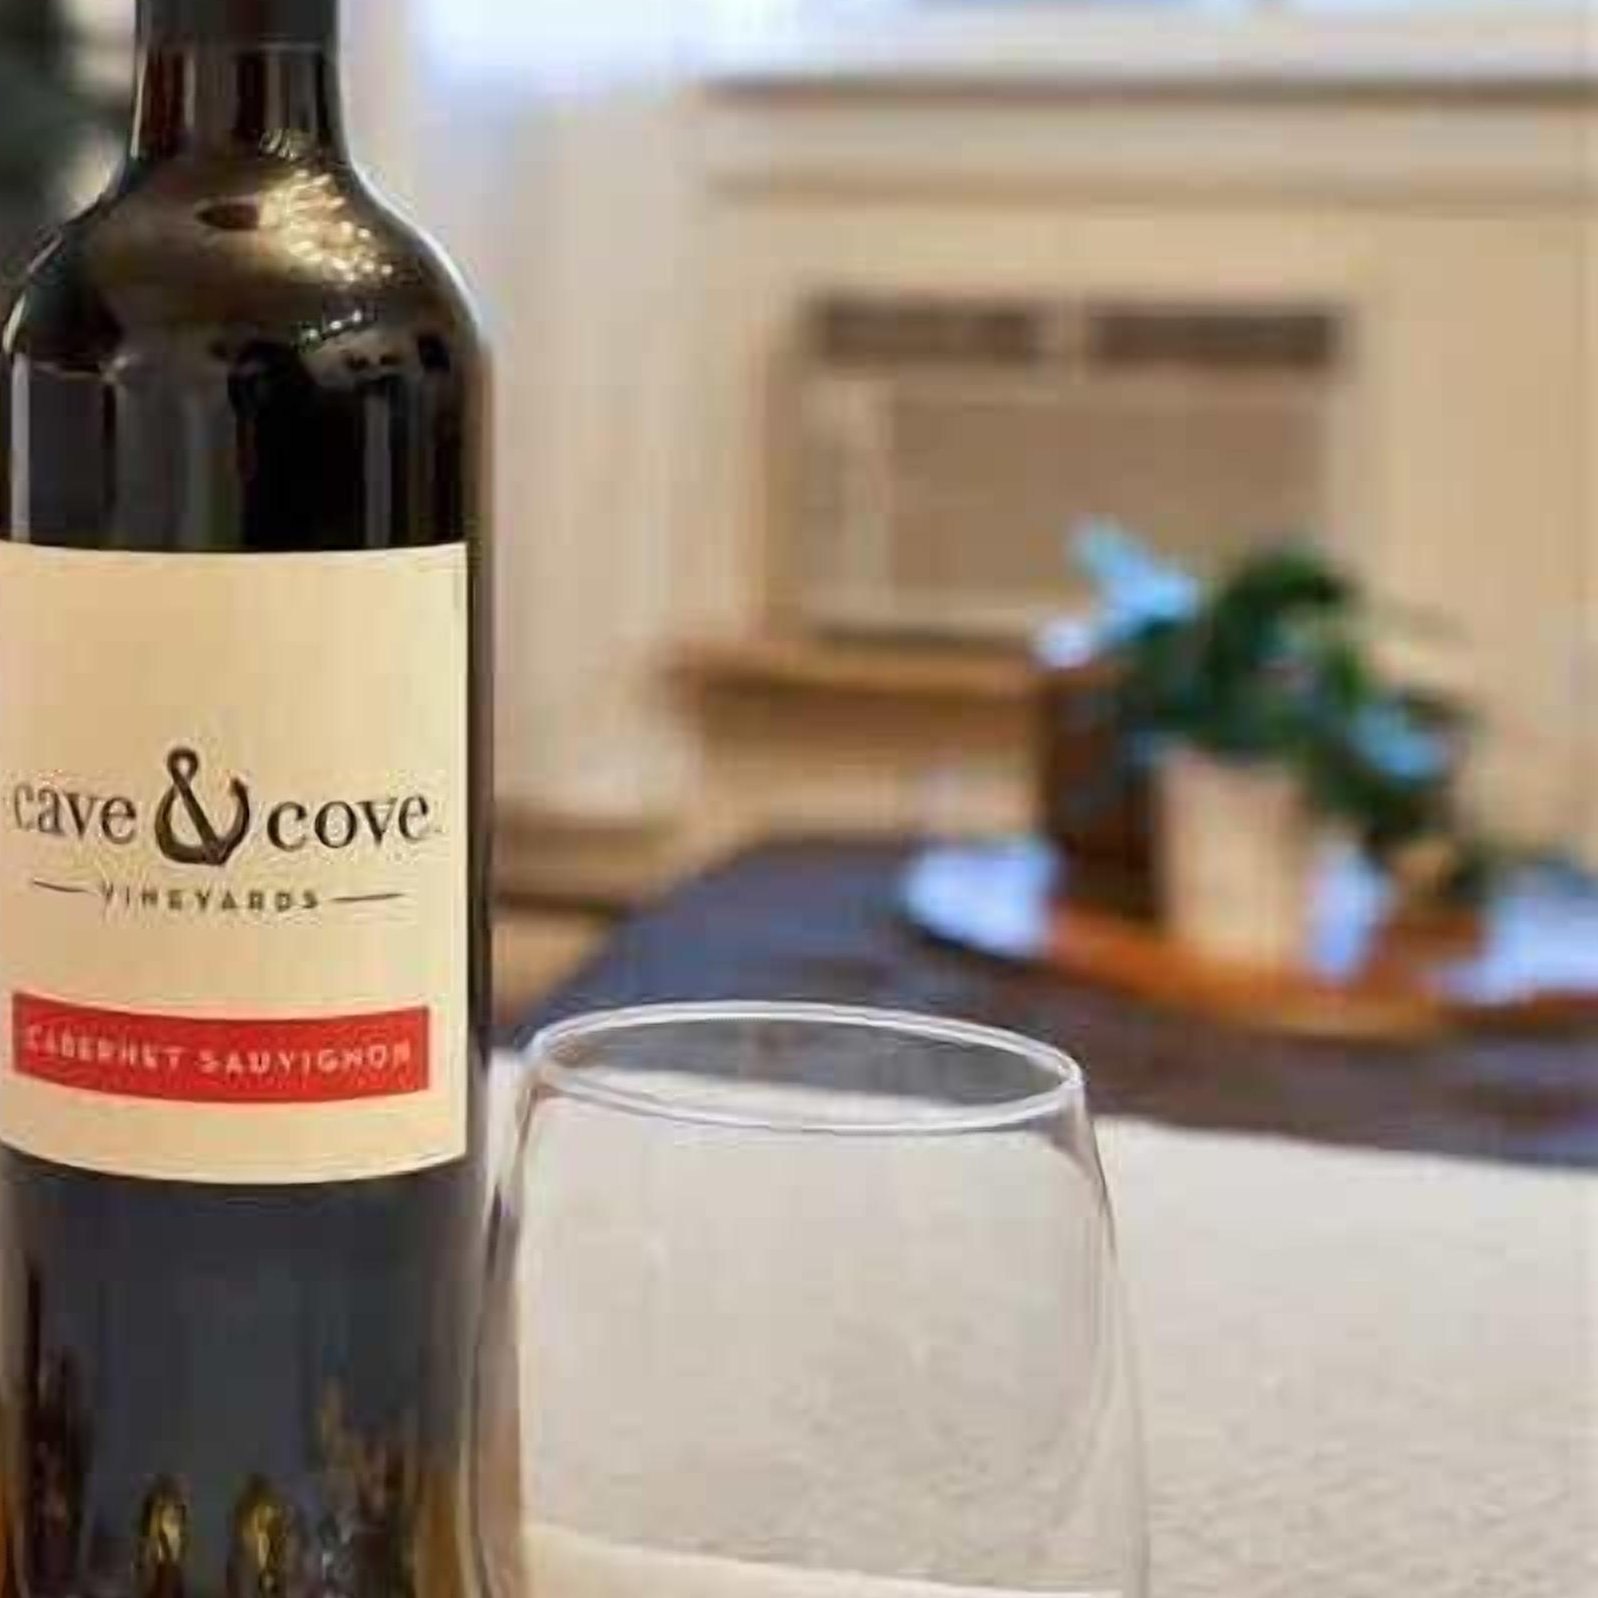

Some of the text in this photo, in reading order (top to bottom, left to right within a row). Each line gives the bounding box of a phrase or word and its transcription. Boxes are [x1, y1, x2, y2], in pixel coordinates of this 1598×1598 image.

[12, 747, 430, 866] cave & cove
[101, 880, 319, 911] VINEYARDS
[25, 1023, 412, 1075] CABERNET SAUVIGNON
